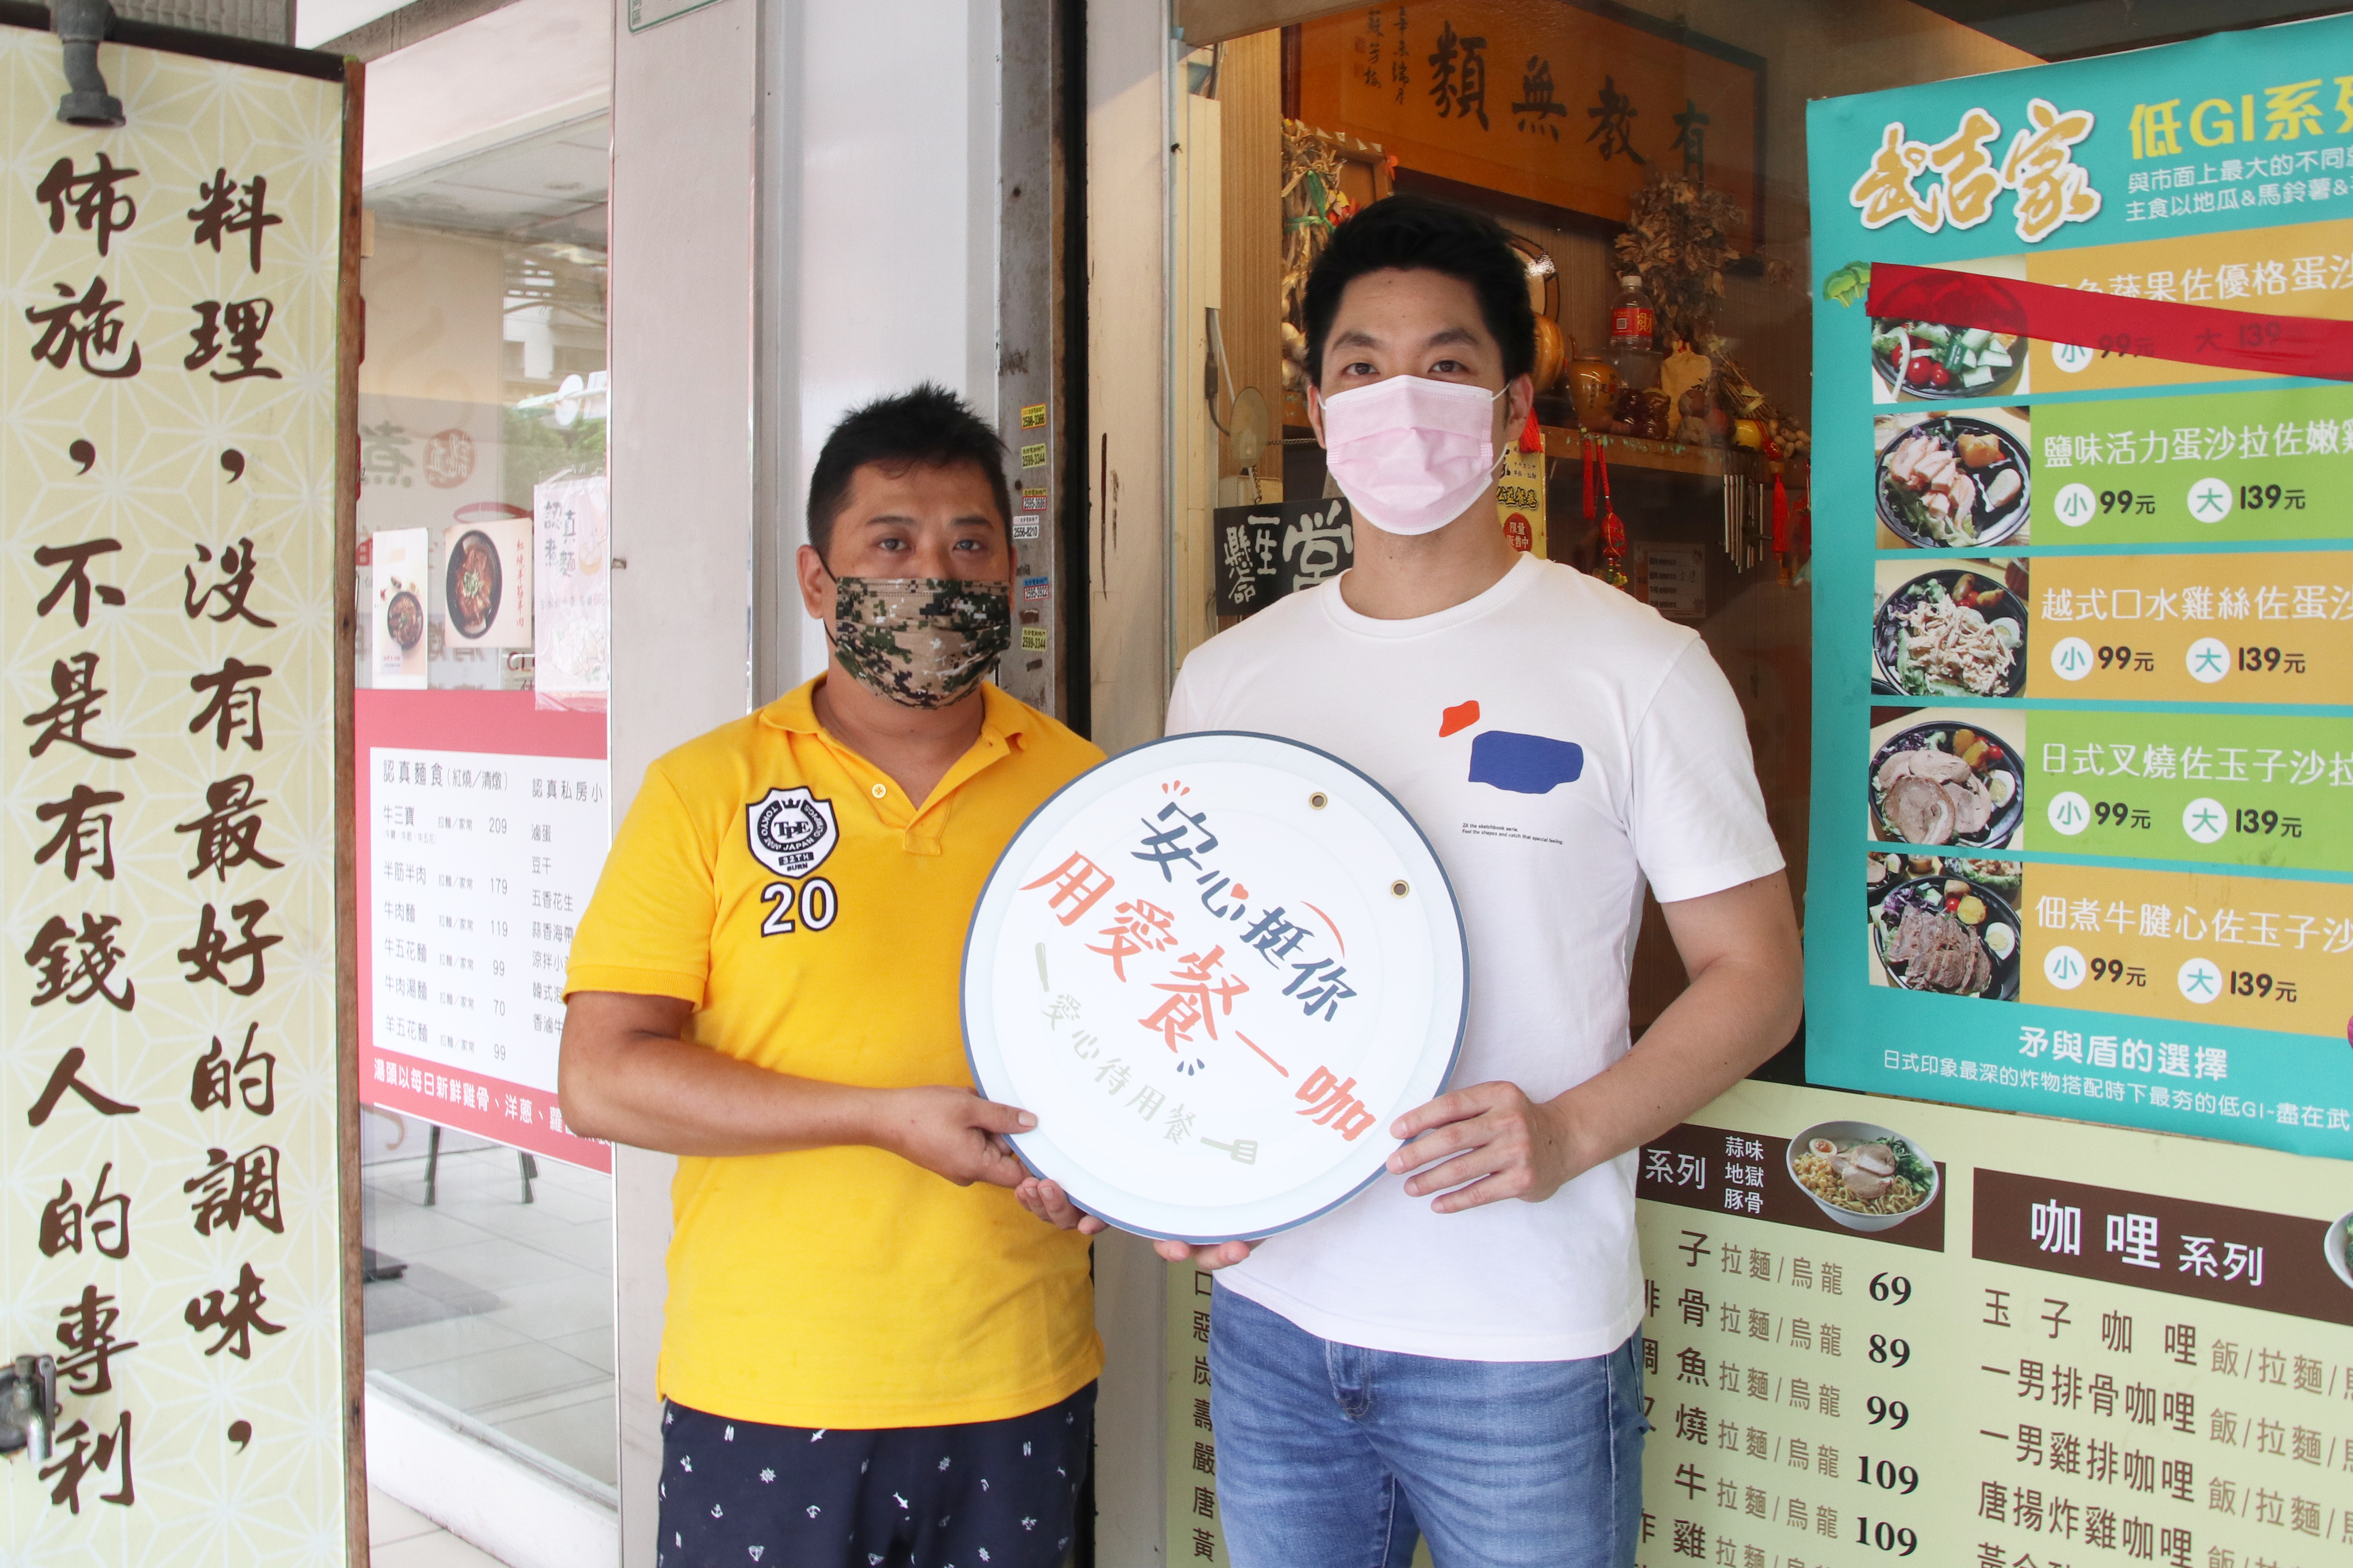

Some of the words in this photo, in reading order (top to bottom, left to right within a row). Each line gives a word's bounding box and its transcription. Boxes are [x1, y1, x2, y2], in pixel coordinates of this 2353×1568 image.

[2128, 145, 2353, 193] 與市面上最大的不同
[2126, 176, 2353, 221] 主食以地瓜&馬鈴薯&
[2062, 492, 2088, 516] 小
[2100, 490, 2156, 515] 99元
[2197, 488, 2223, 513] 大
[2239, 484, 2306, 511] 139元
[1510, 522, 1526, 536] 限量
[1022, 636, 1046, 649] 2599-3344
[507, 651, 535, 672] CL
[2059, 647, 2086, 671] 小
[2098, 646, 2155, 672] 99元
[2194, 647, 2222, 674] 大
[2238, 646, 2306, 674] 139元
[532, 778, 607, 803] 認真私房小
[489, 817, 507, 834] 209
[761, 806, 778, 836] TOKYO
[783, 837, 814, 851] JAPAN
[2056, 801, 2083, 825] 小
[2094, 802, 2152, 830] 99元
[2191, 807, 2219, 833] 大
[2235, 808, 2302, 838] 139元
[532, 856, 552, 875] 豆干
[782, 853, 810, 865] 32TH
[786, 863, 808, 871] BURN
[490, 878, 507, 894] 179
[532, 888, 573, 912] 五香花生
[761, 877, 838, 937] 20
[1130, 802, 1357, 1021] 安心挺你
[490, 920, 508, 937] 119
[493, 960, 505, 976] 99
[532, 950, 566, 972] 涼拌小
[1018, 850, 1376, 1141] 用愛餐一咖
[2052, 955, 2078, 980] 小
[2090, 958, 2147, 987] 99元
[2186, 968, 2214, 994] 大
[2230, 971, 2297, 1002] 139元
[493, 1000, 505, 1017] 70
[493, 1044, 506, 1060] 99
[1041, 993, 1196, 1145] 愛心待用餐
[2019, 1026, 2228, 1082] 矛與盾的選擇
[1725, 1135, 1764, 1161] 蒜味
[1645, 1147, 1706, 1190] 系列
[1725, 1162, 1764, 1188] 地獄
[1723, 1188, 1764, 1215] 豚骨
[2031, 1198, 2161, 1269] 咖哩
[2178, 1234, 2264, 1287] 系列
[1721, 1242, 1843, 1296] 拉麵/烏龍
[1869, 1271, 1912, 1307] 69
[1720, 1301, 1842, 1357] 拉麵/烏龍
[1867, 1333, 1911, 1368] 89
[1982, 1287, 2197, 1366] 玉子咖哩
[1719, 1360, 1841, 1419] 拉麵/烏龍
[1866, 1395, 1909, 1430] 99
[1981, 1358, 2196, 1435] 一男排骨咖哩
[1718, 1418, 1840, 1479] 拉麵/烏龍
[1857, 1455, 1919, 1496] 109
[1980, 1423, 2195, 1503] 一男雞排咖哩
[1193, 1486, 1215, 1519] 唐
[1674, 1462, 1707, 1500] 牛
[1716, 1477, 1838, 1540] 拉麵/烏龍
[1856, 1516, 1918, 1557] 109
[1978, 1480, 2193, 1568] 唐揚炸雞咖哩
[1193, 1527, 1215, 1562] 黃
[1715, 1535, 1832, 1568] 拉麵/
